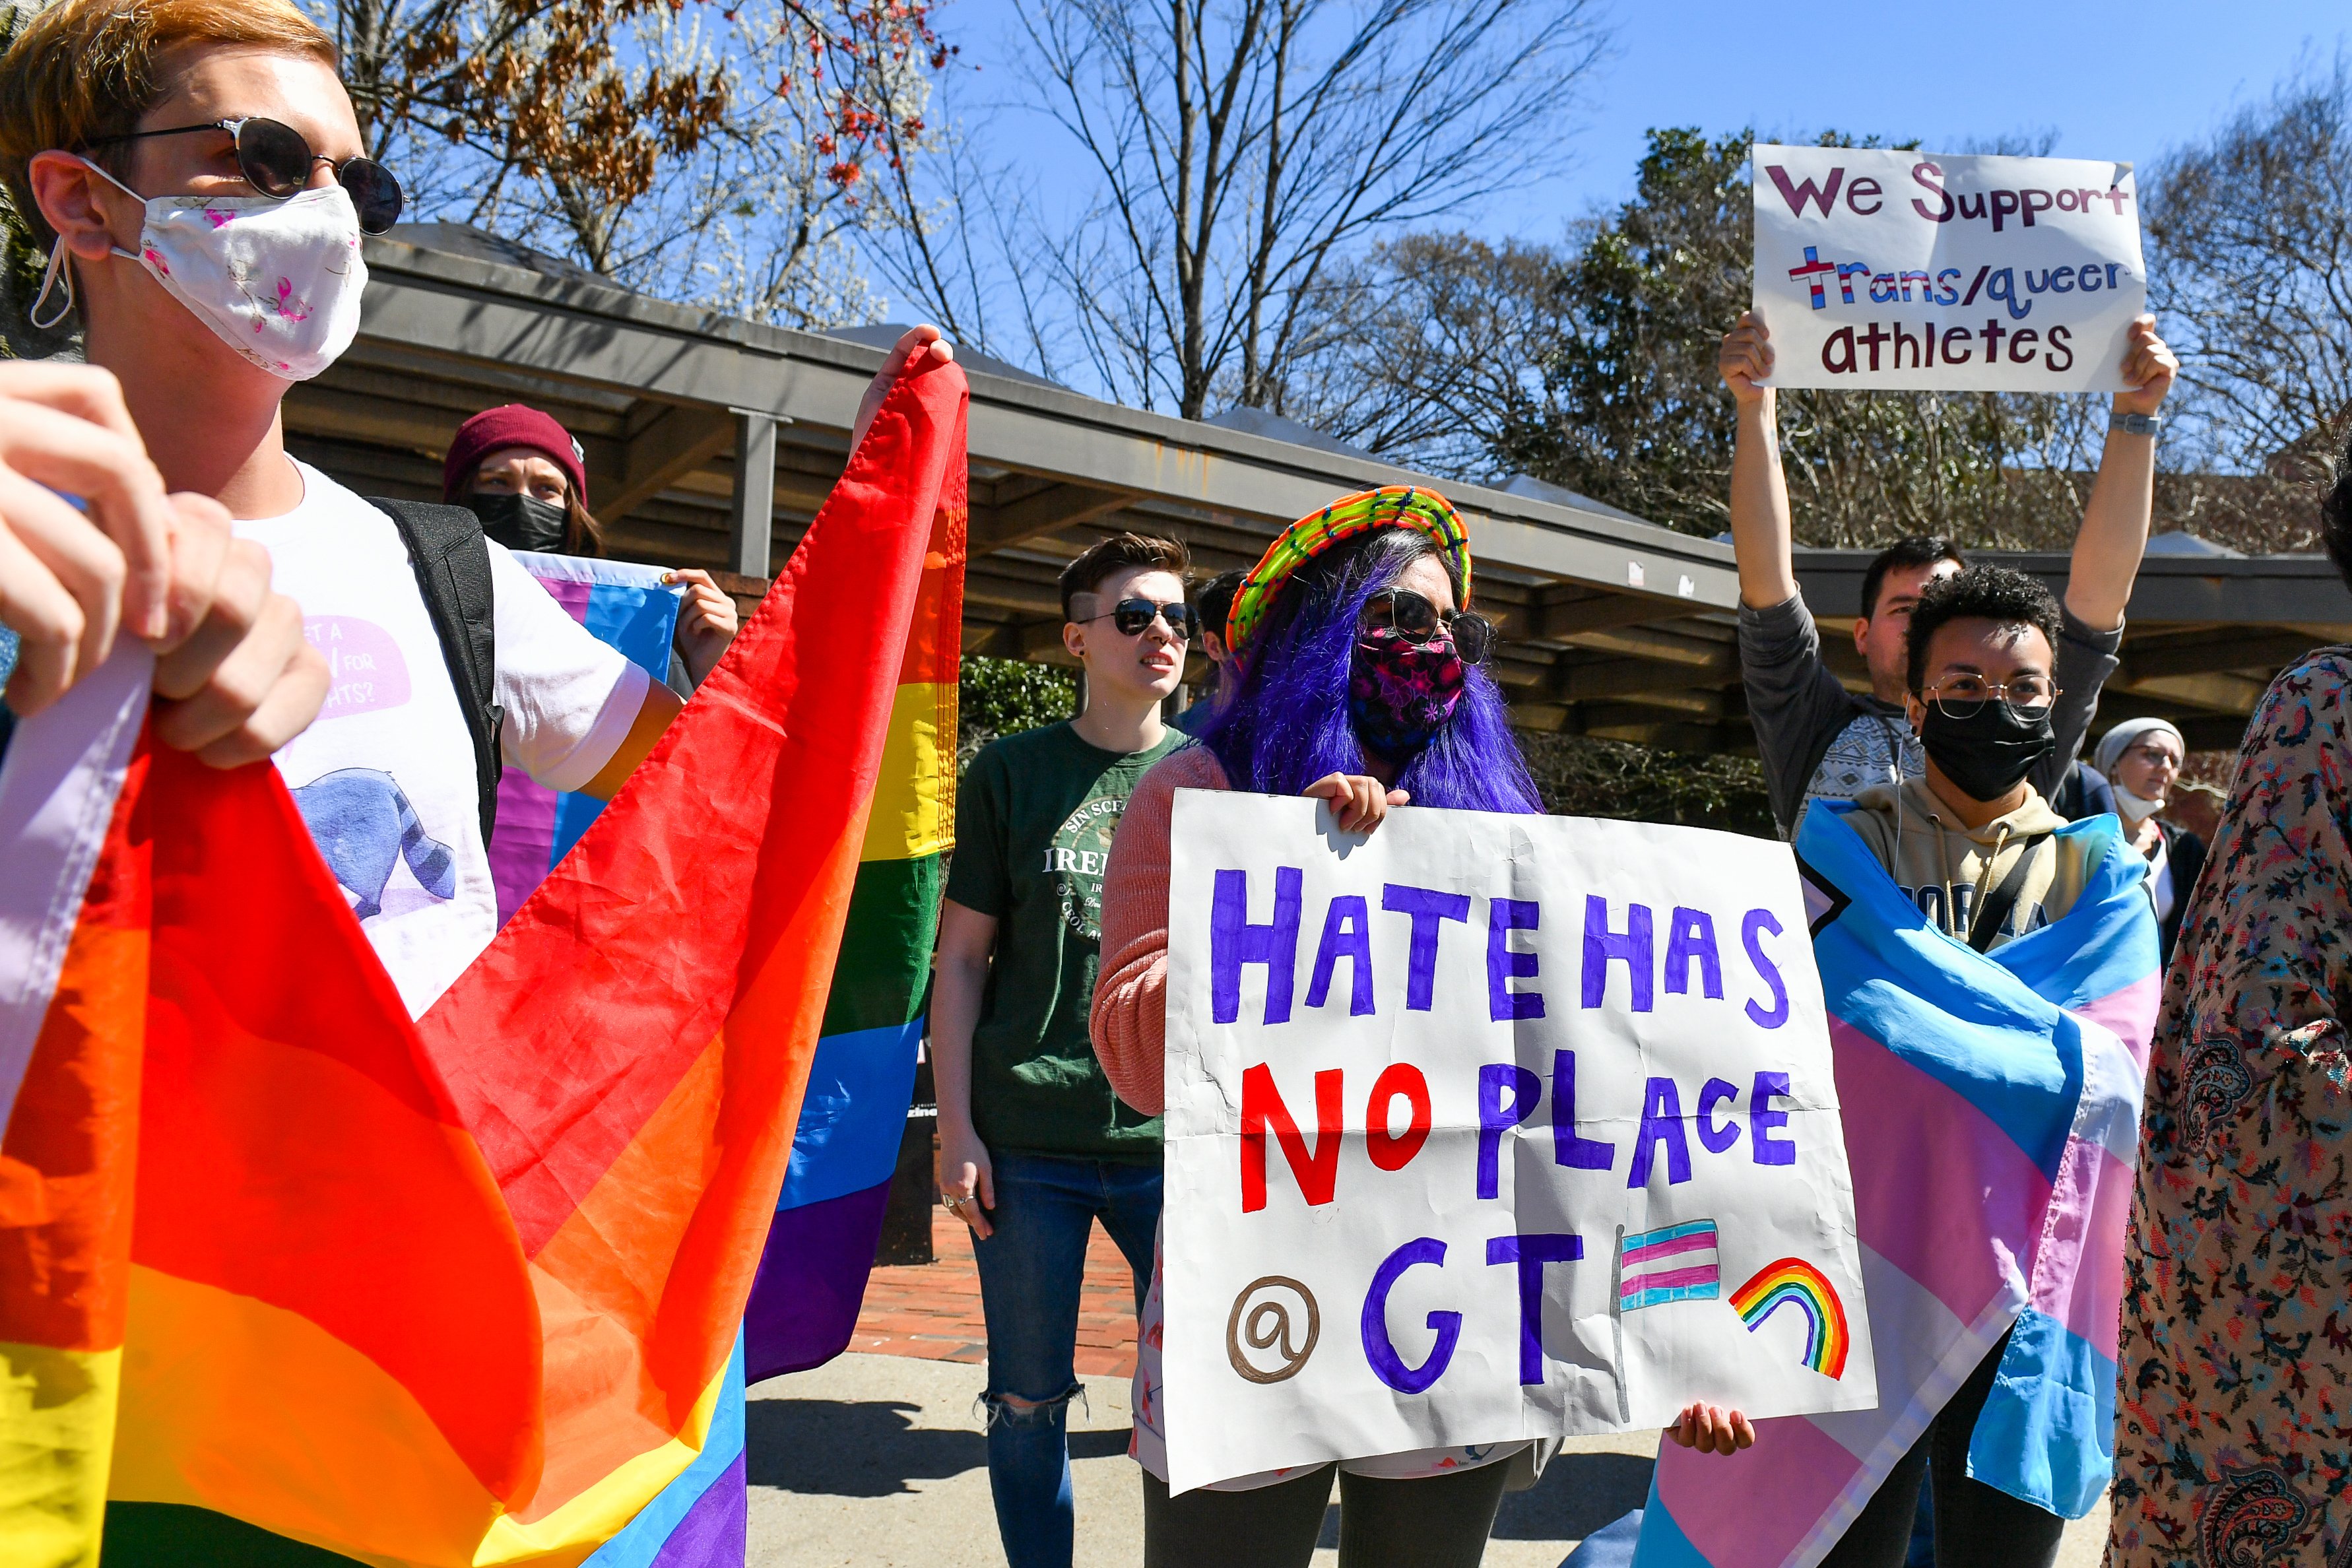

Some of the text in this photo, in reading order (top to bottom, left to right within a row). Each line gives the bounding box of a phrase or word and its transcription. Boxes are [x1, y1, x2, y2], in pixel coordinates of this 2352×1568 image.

[1765, 162, 2129, 232] We Support
[1789, 246, 2131, 319] trans/queer
[1822, 319, 2074, 374] athletes
[331, 622, 343, 641] A
[343, 653, 377, 670] FOR
[1065, 809, 1090, 833] SIN
[1211, 866, 1789, 1029] HATE HAS
[1241, 1049, 1796, 1213] NO PLACE
[1226, 1233, 1584, 1394] @ GT
